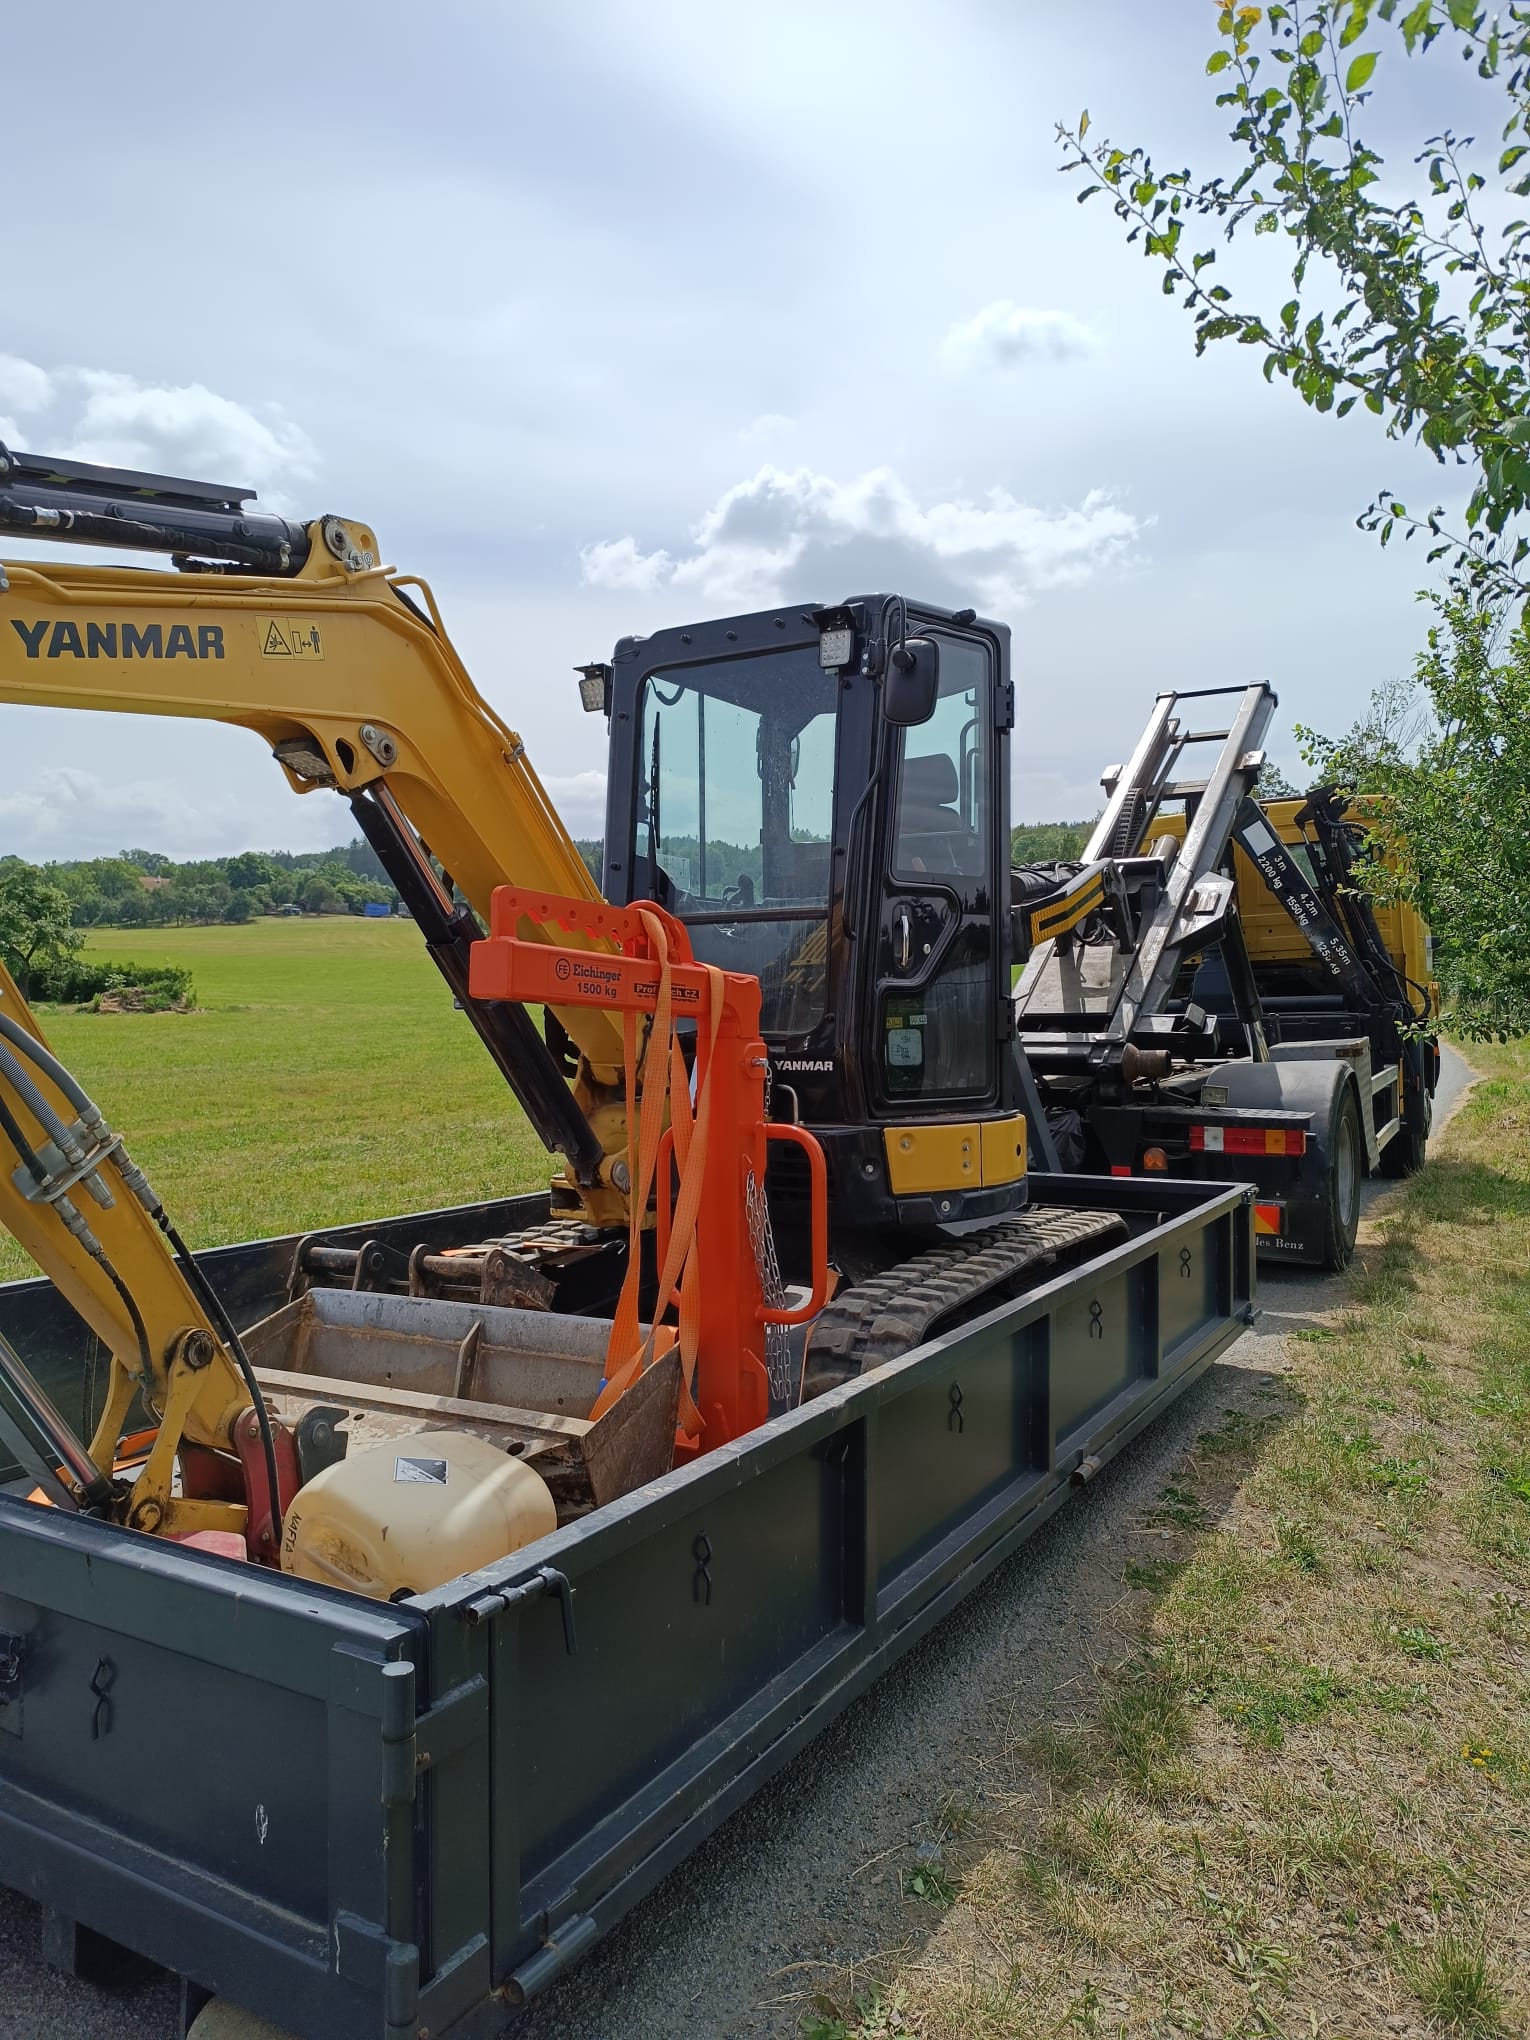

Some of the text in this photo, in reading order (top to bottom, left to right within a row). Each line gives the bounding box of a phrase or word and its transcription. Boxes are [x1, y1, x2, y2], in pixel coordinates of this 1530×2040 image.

[10, 619, 225, 659] YANMAR
[1257, 855, 1284, 889] 2200 kg
[1286, 895, 1309, 926] 1550 kg
[1300, 893, 1319, 917] 4,2m
[1330, 937, 1351, 965] 5,35m
[573, 963, 622, 982] Eichinger
[577, 982, 617, 998] 1500 kg
[684, 989, 697, 998] CZ
[774, 1060, 834, 1071] YANMAR
[1275, 1238, 1304, 1250] Benz
[285, 1510, 303, 1553] NAFTA
